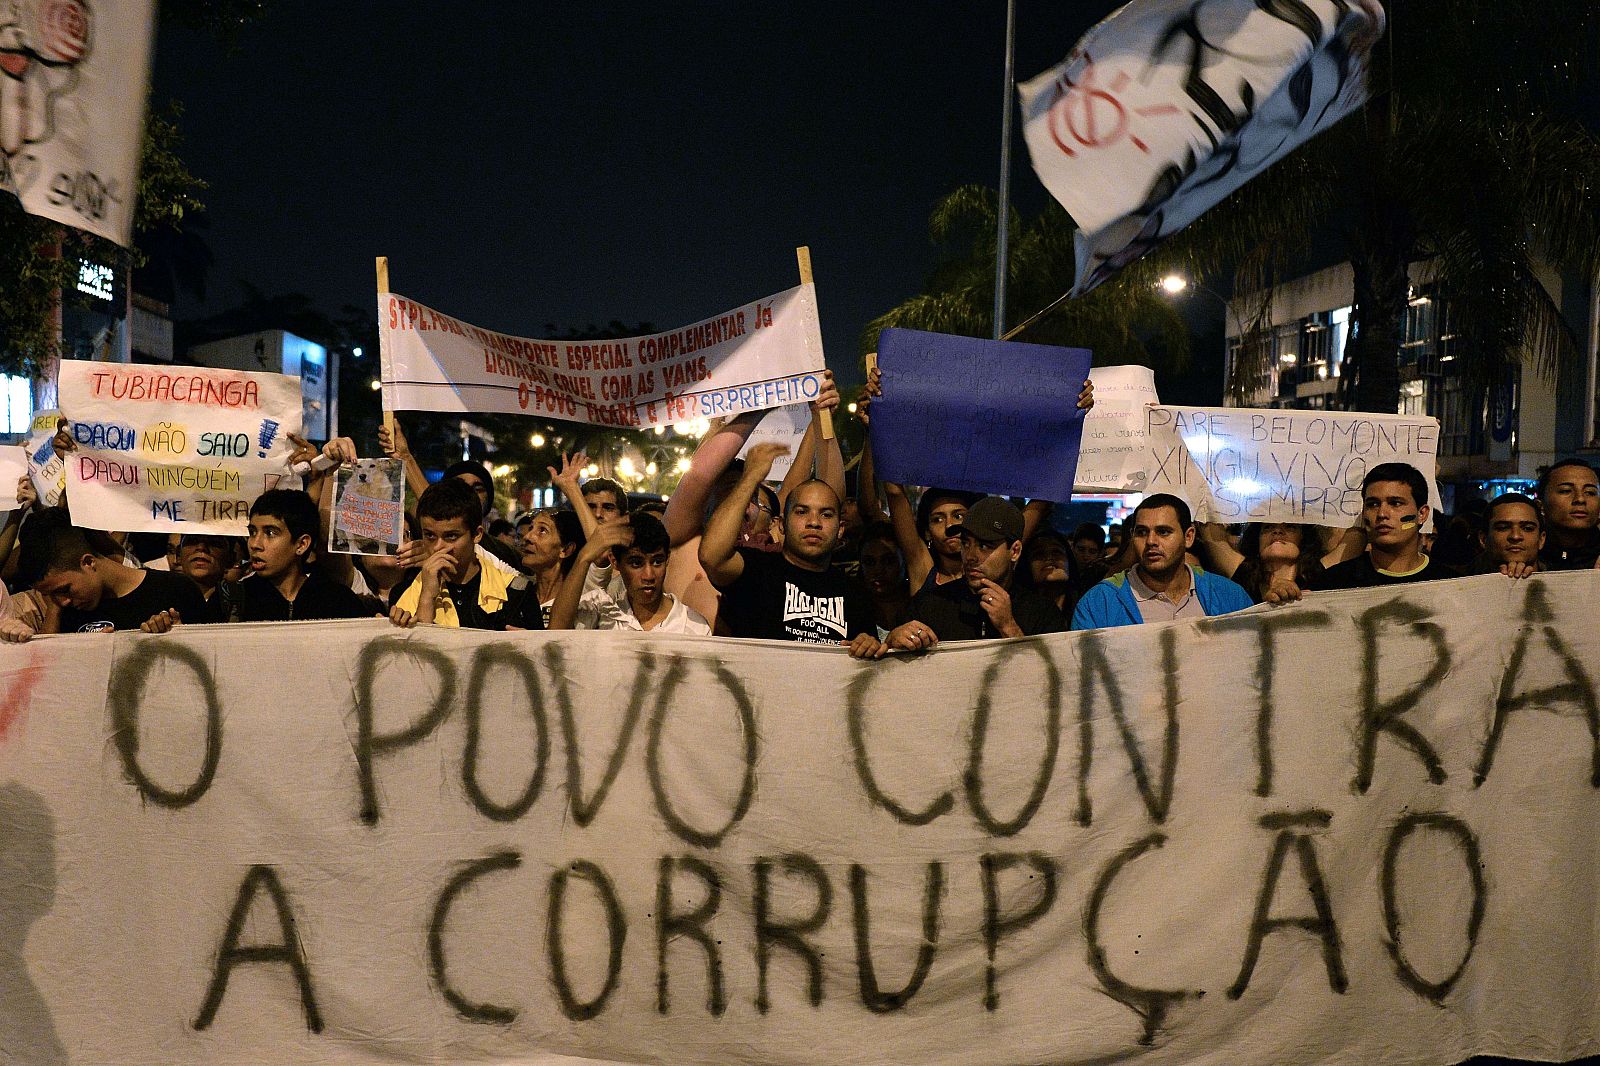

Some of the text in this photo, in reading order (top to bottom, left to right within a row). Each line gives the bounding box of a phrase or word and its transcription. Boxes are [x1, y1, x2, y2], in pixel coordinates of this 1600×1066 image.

[473, 328, 559, 368] TRANSPORTE
[566, 343, 632, 371] ESPECIAL
[638, 311, 746, 365] COMPLEMENTAR
[754, 300, 774, 330] Já
[93, 373, 259, 406] TUBIACANGA
[484, 348, 712, 401] LICITAÇÃO CRUEL COM AS VANS.
[518, 382, 529, 409] O
[535, 385, 577, 416] POVO
[74, 423, 137, 451] DAQUI
[142, 421, 187, 454] NÃO
[196, 432, 251, 458] SAIO
[1148, 409, 1436, 454] PARE BELOMONTE
[80, 456, 139, 485] DAQUI
[147, 462, 240, 491] NINGUÉM
[1076, 469, 1118, 484] uturo
[1151, 445, 1259, 487] XINGU
[1271, 452, 1366, 491] VIVO
[152, 499, 250, 522] ME TIRA
[1213, 486, 1362, 520] SEMPRE
[106, 577, 1600, 849] O POVO CONTRA
[190, 808, 1487, 1047] A CORRUPÇÃO
